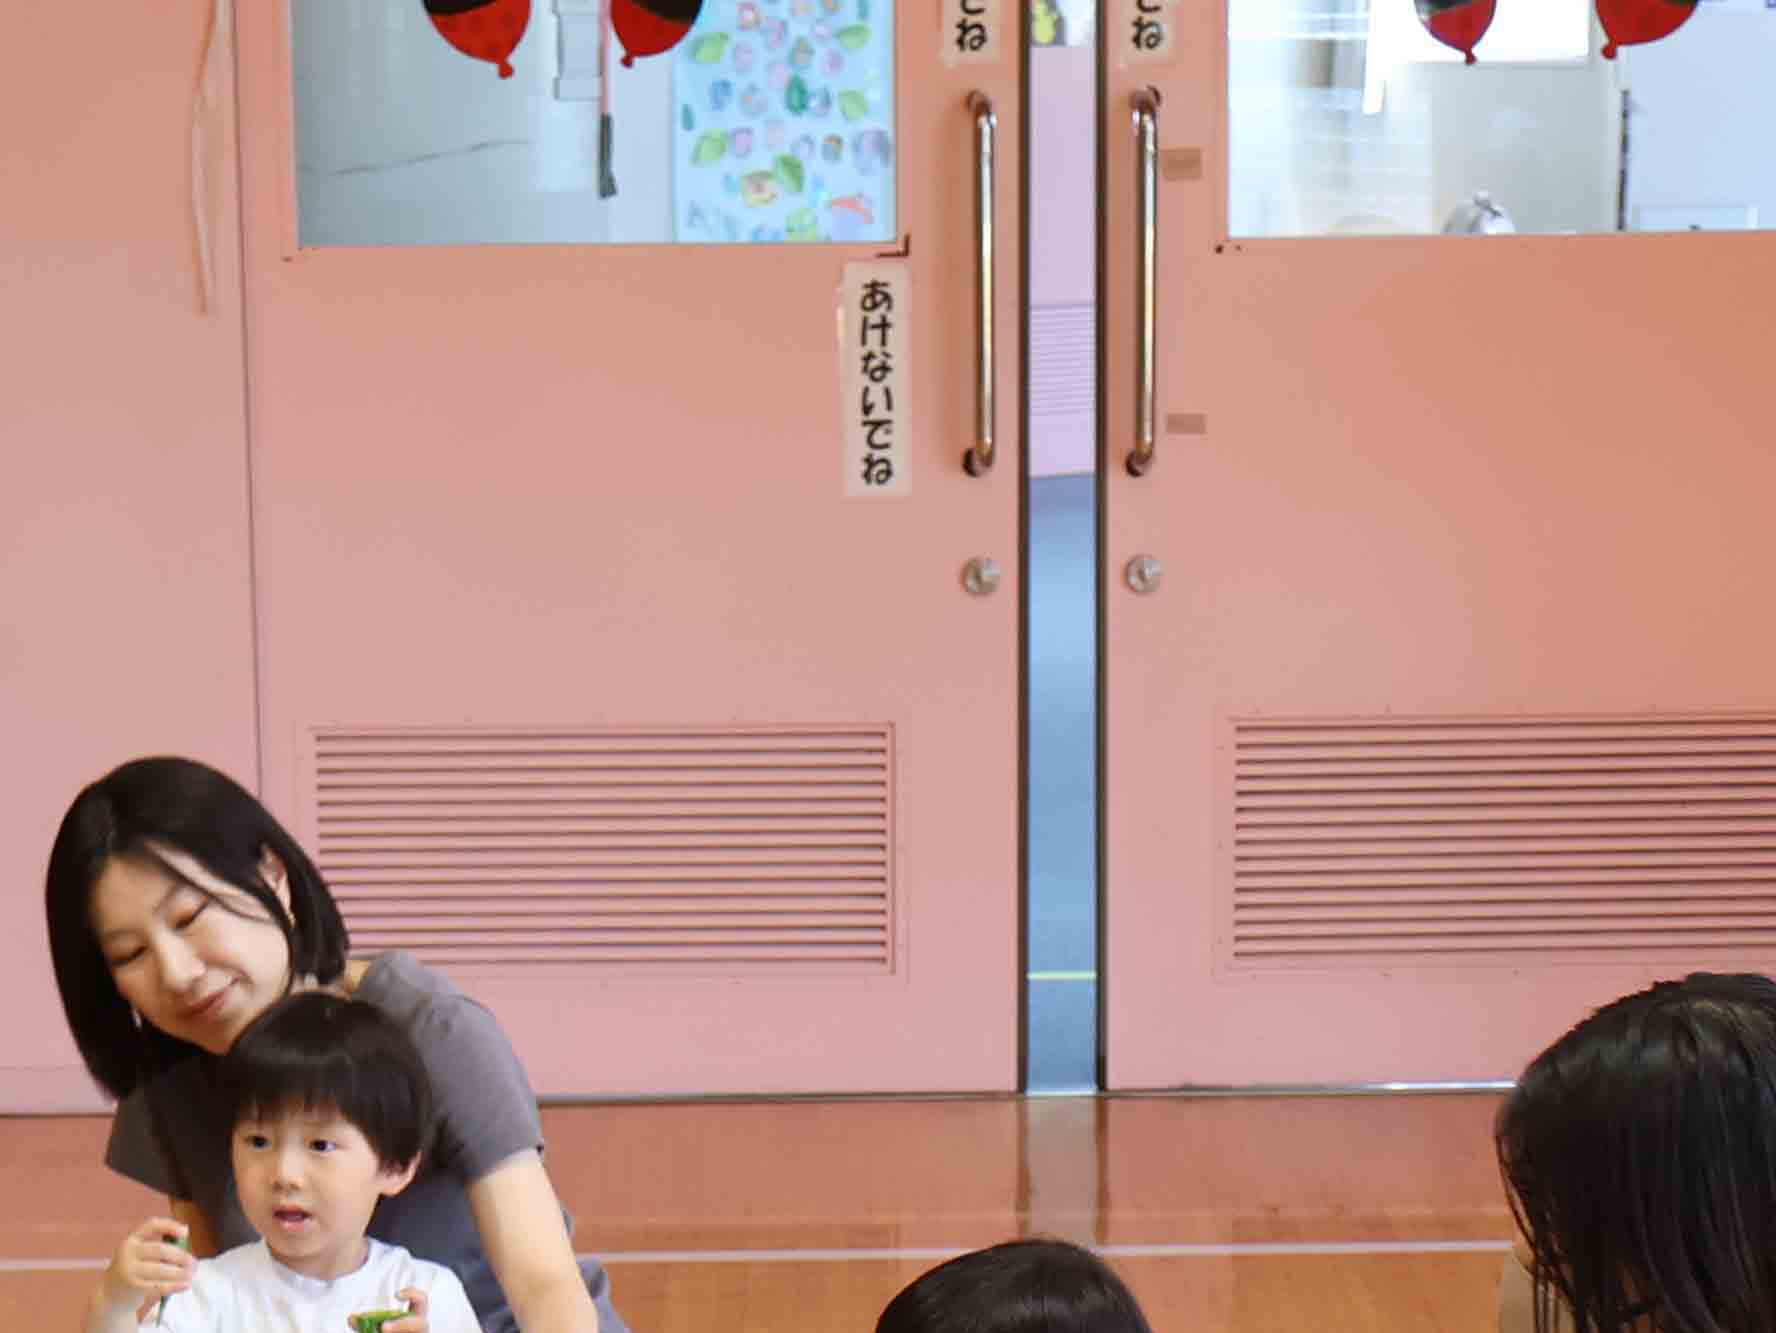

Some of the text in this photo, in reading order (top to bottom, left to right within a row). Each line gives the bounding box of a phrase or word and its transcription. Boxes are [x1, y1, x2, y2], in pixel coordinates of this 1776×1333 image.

[860, 279, 893, 485] あけないでね
